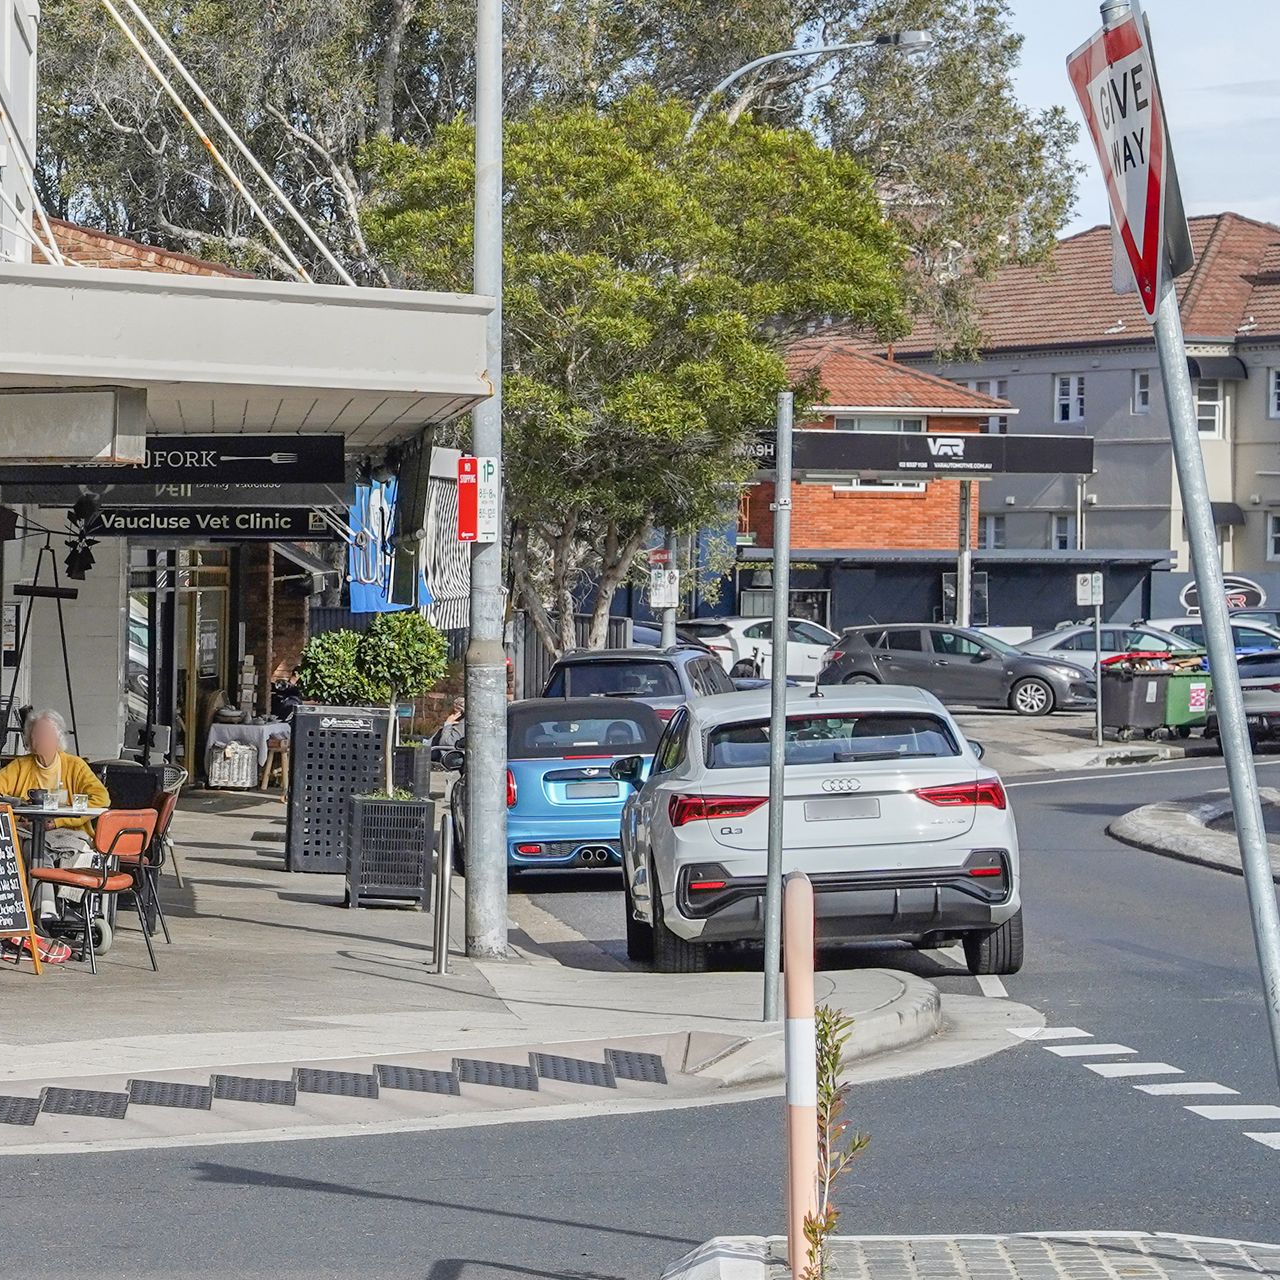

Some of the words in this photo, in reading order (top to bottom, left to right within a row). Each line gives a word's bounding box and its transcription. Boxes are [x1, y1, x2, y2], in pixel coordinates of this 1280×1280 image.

[1100, 63, 1148, 130] GIVE
[1111, 127, 1144, 177] WAY
[153, 450, 218, 468] FORK
[101, 513, 190, 530] Vaucluse
[196, 514, 230, 530] Vet
[236, 512, 292, 529] Clinic
[721, 827, 743, 835] Q3
